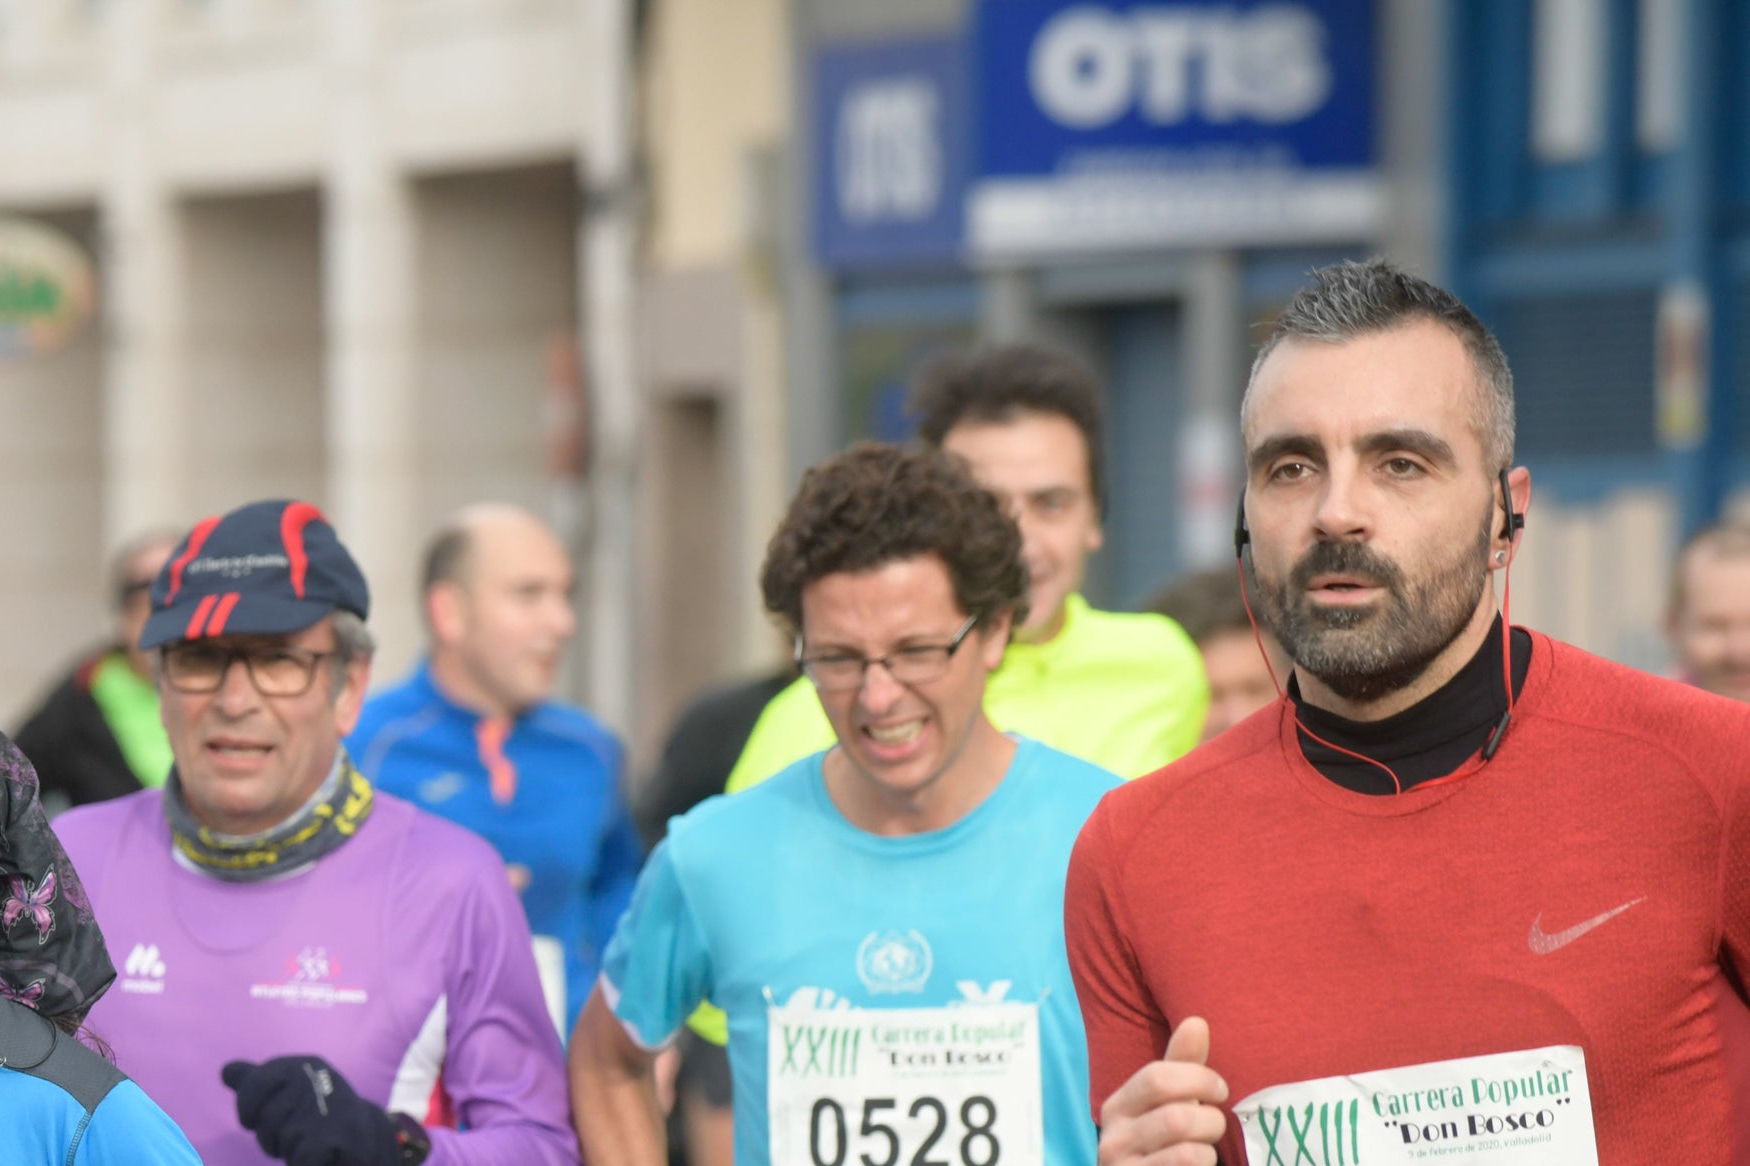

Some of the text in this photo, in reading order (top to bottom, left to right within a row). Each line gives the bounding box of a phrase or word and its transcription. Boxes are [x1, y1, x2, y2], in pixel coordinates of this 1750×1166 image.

[1029, 3, 1330, 129] OTIS
[781, 1025, 860, 1077] XXIII
[1372, 1069, 1573, 1117] Carrera Popular
